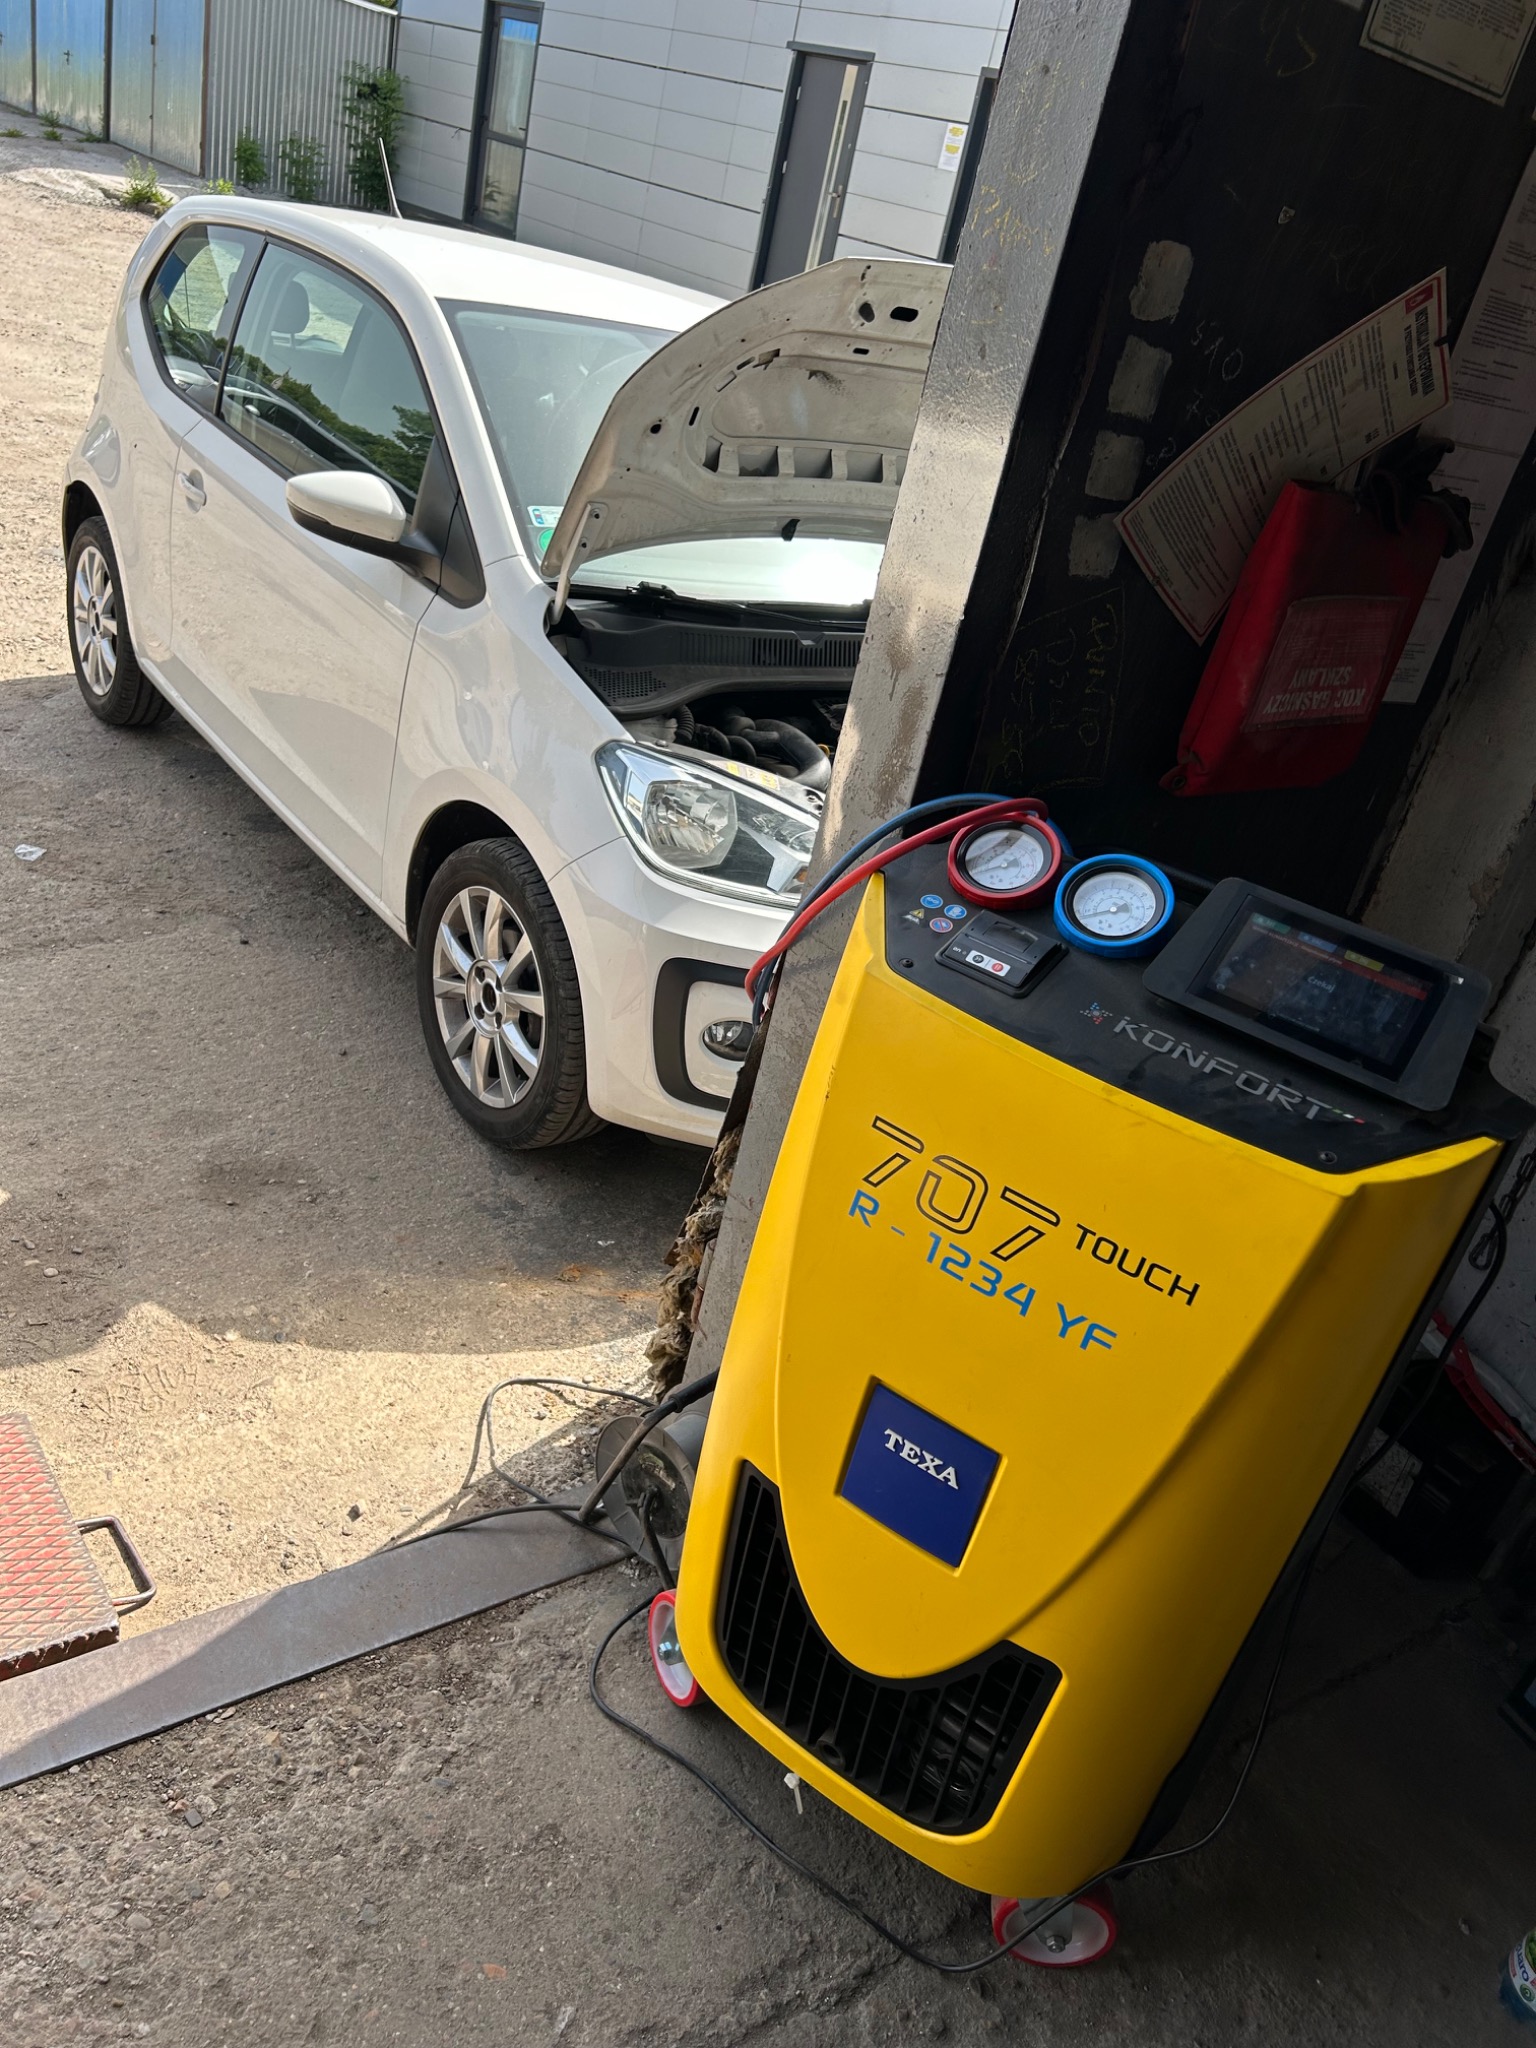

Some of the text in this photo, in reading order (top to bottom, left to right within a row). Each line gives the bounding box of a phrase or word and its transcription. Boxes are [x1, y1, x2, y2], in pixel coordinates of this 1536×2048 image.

[1262, 688, 1366, 715] KOC GAŚNICZY
[1288, 666, 1352, 689] SZKLANY
[1306, 975, 1336, 994] Czekaj
[1113, 1016, 1333, 1120] KONFORT
[862, 1115, 1200, 1306] 707 TOUCH
[848, 1189, 880, 1228] R
[925, 1231, 1037, 1317] 1234
[1056, 1302, 1118, 1350] YF
[884, 1428, 959, 1490] TEXA
